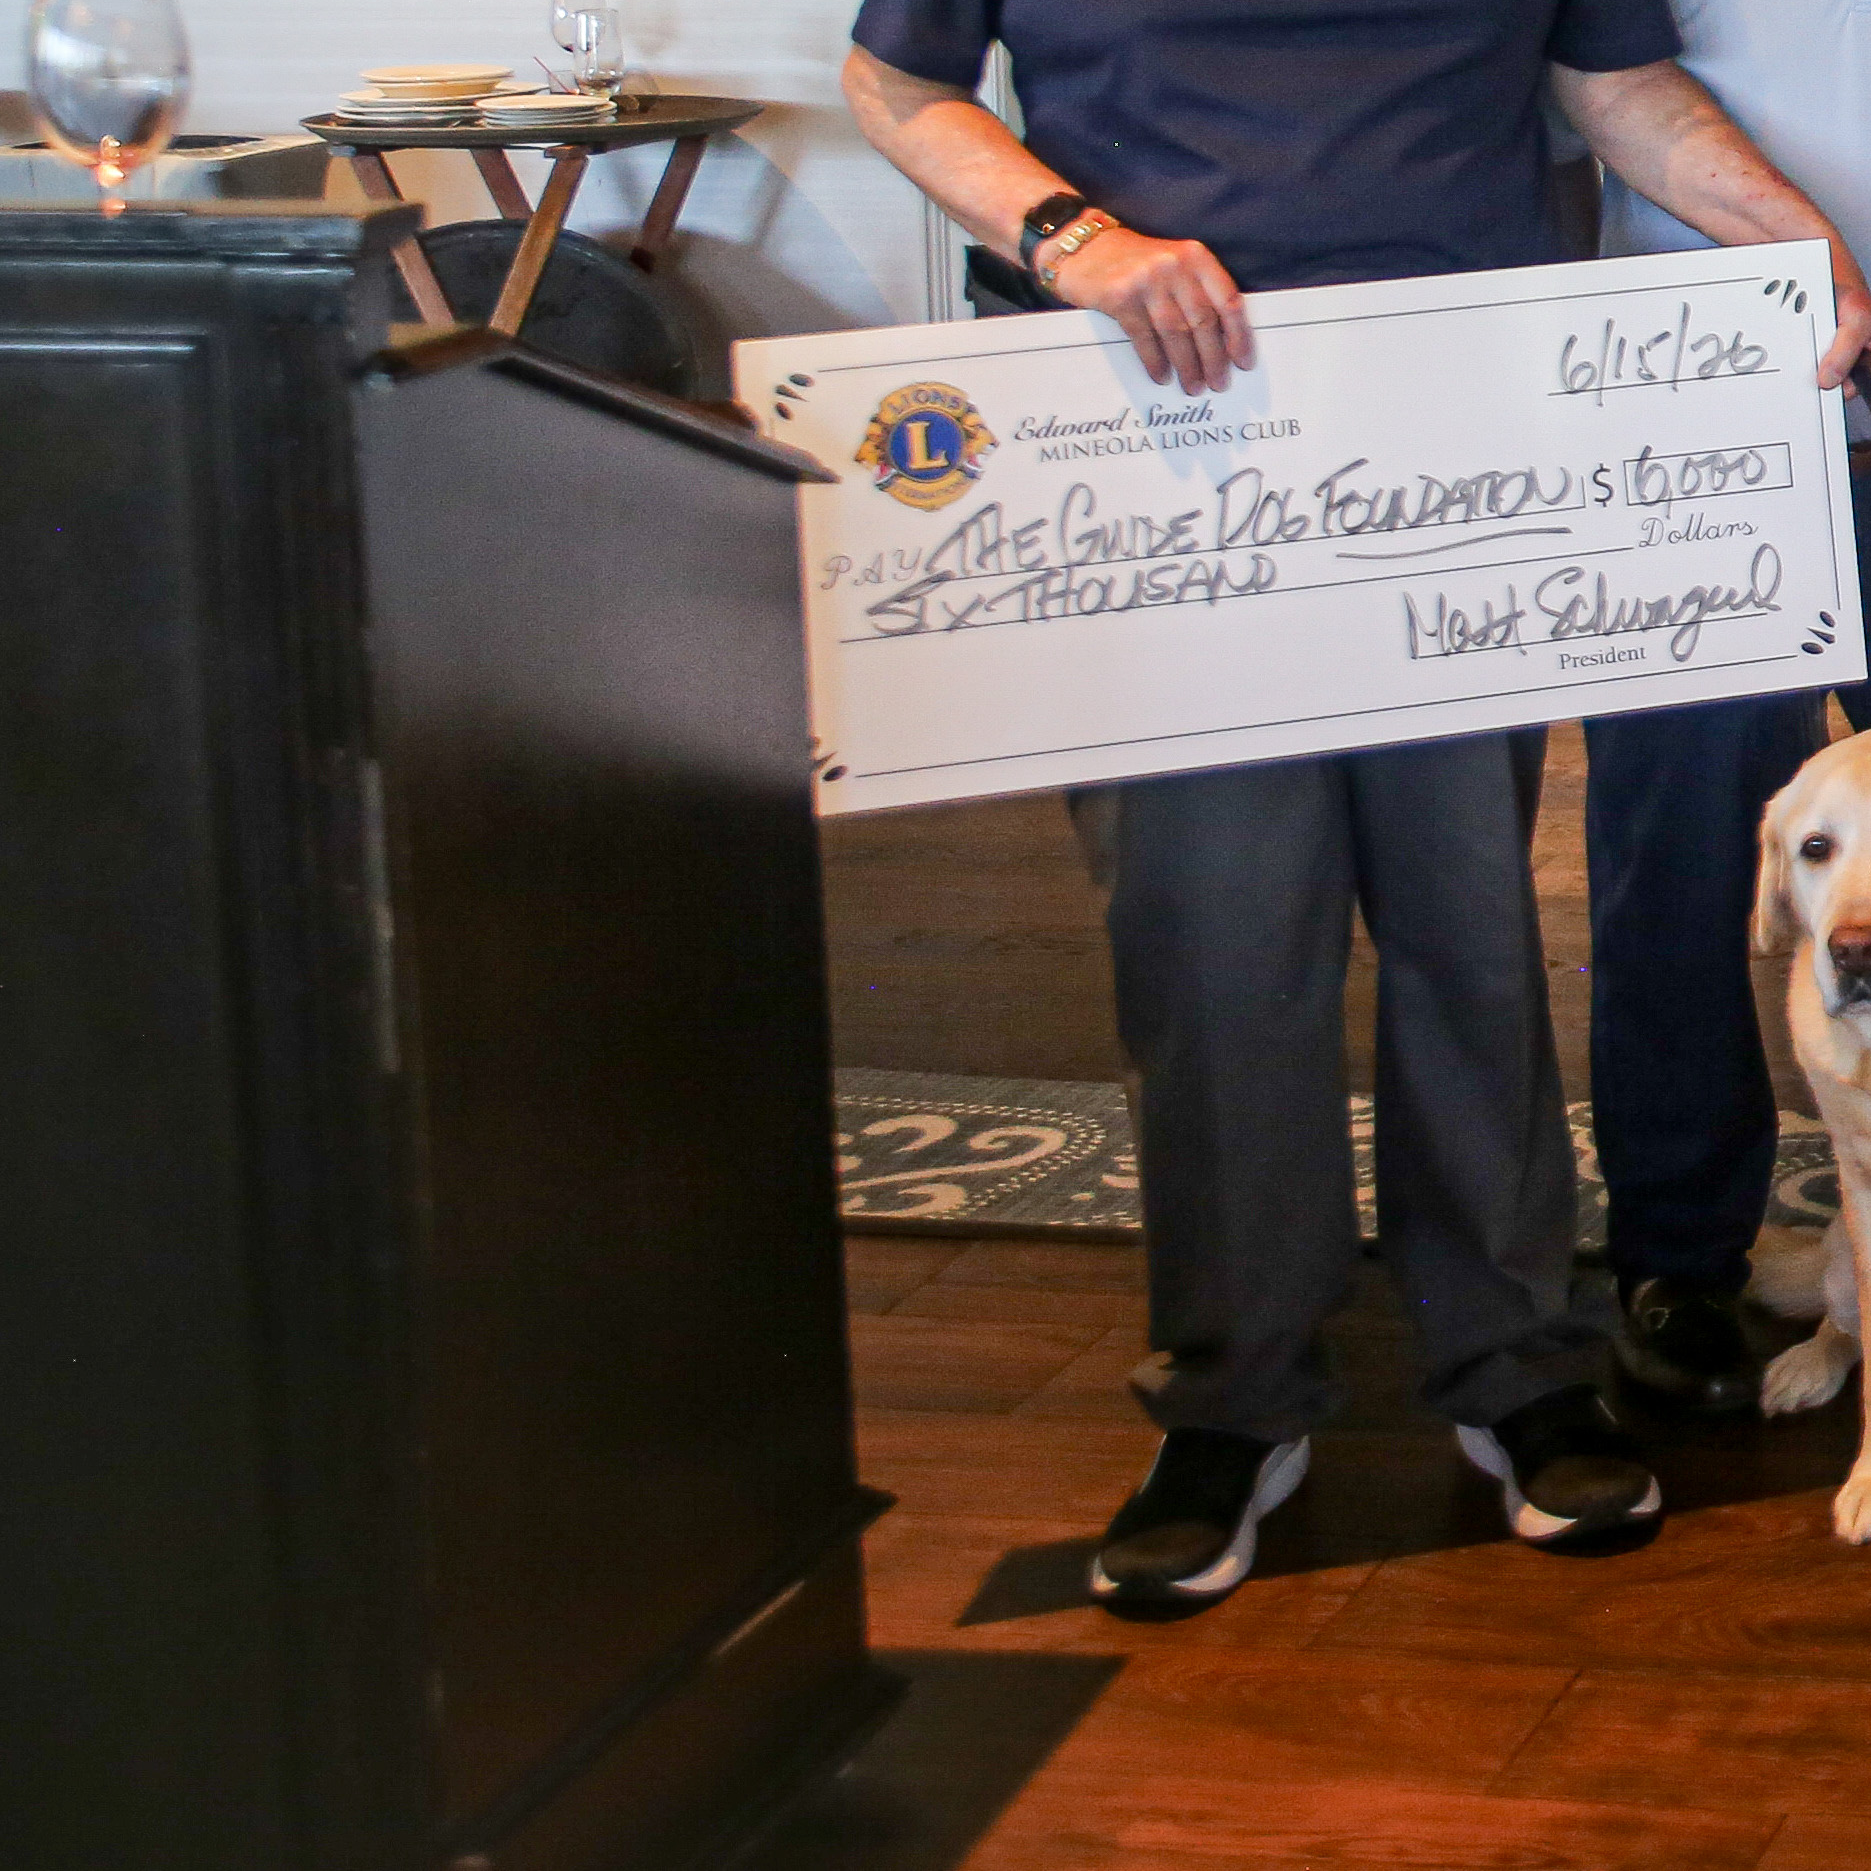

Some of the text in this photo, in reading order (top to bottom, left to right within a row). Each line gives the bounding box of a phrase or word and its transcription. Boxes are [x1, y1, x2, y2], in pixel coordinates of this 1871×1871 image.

[1561, 301, 1768, 406] 6/15/26
[1014, 403, 1215, 441] Edward Smith
[1040, 418, 1302, 463] MINEOLA LIONS CLUB
[905, 420, 950, 470] L
[1592, 464, 1614, 507] $
[926, 501, 1047, 578] THE
[1315, 458, 1574, 536] FOUNDATION
[1639, 514, 1758, 548] Dollars
[867, 554, 1278, 636] SIX THOUSAND
[1559, 646, 1647, 670] President
